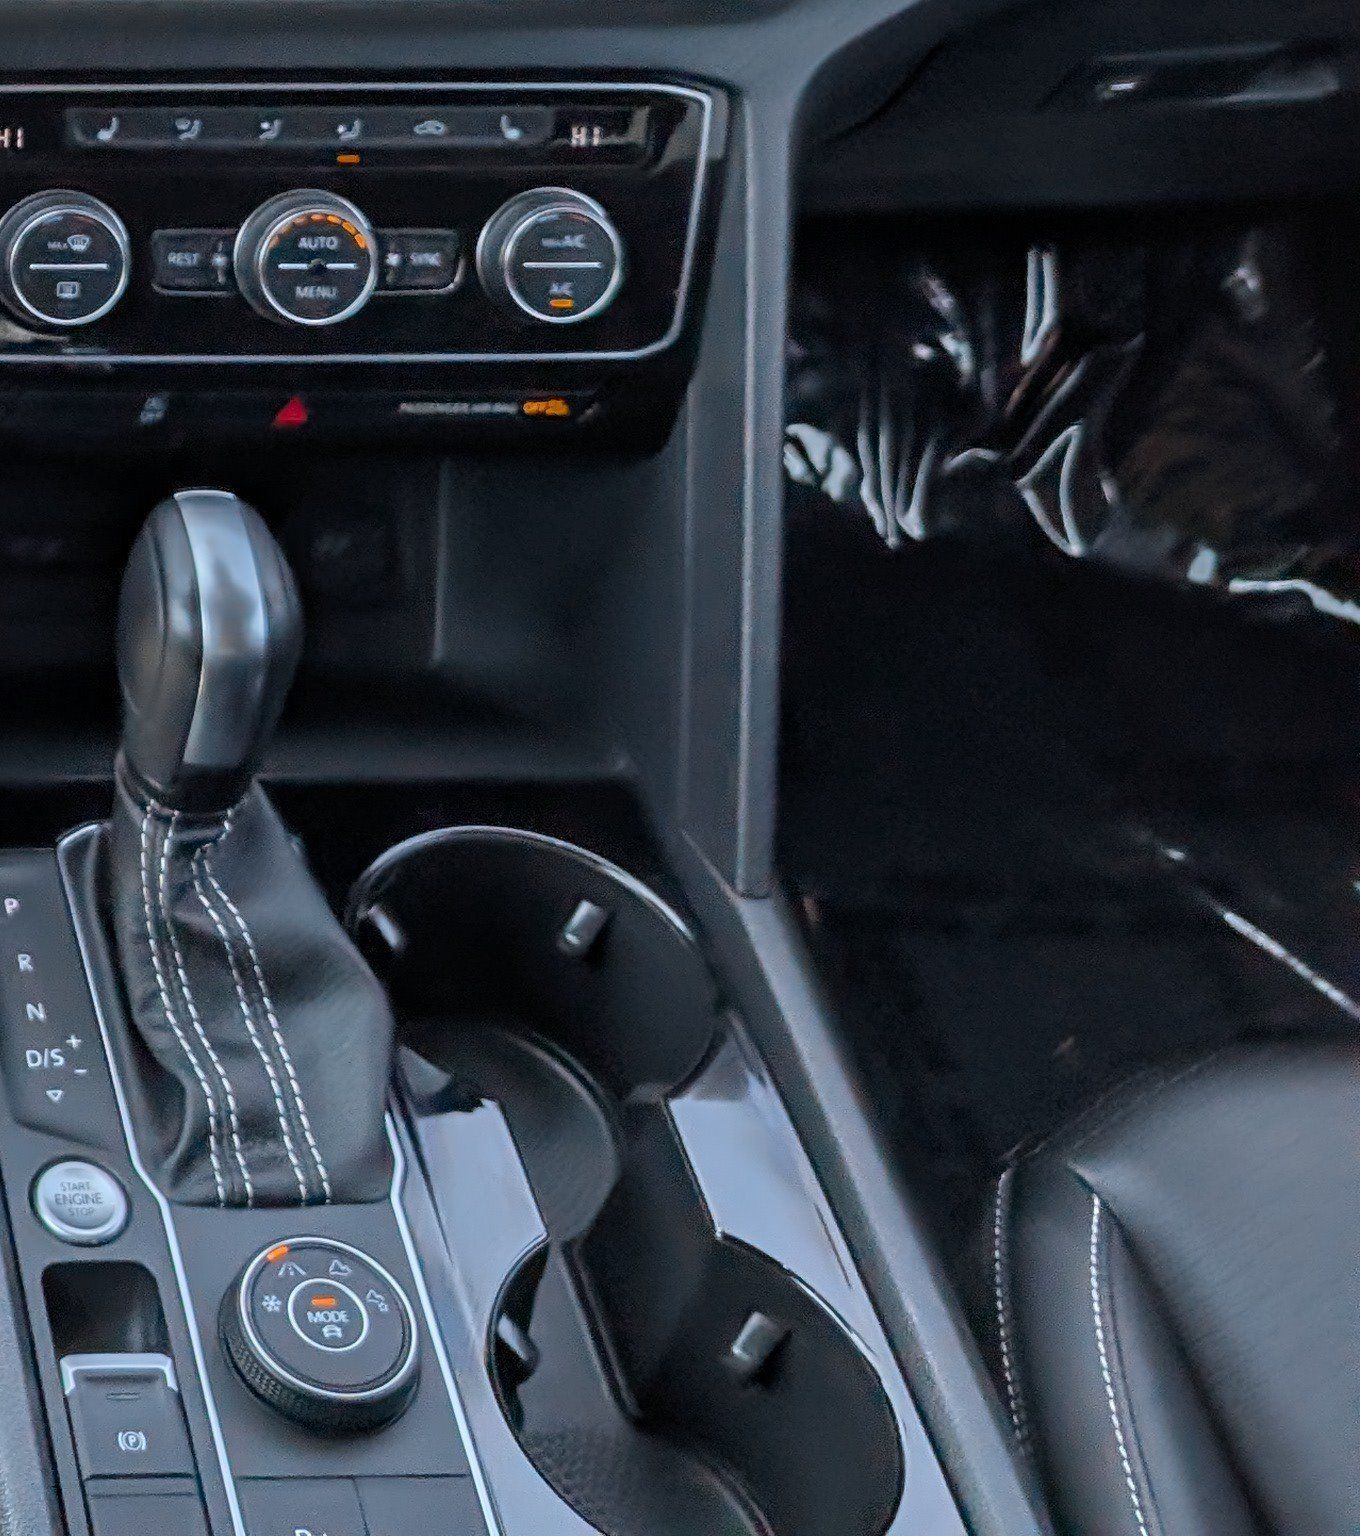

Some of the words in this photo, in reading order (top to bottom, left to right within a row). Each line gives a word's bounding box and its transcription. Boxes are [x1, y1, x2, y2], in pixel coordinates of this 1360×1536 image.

[298, 235, 340, 251] AUTO
[167, 252, 201, 266] REST
[409, 252, 442, 267] SYNC
[295, 285, 338, 300] MENU
[4, 897, 20, 914] P
[17, 953, 33, 972] R
[26, 1001, 47, 1022] N
[60, 1181, 91, 1192] START
[54, 1192, 104, 1206] ENGINE
[67, 1207, 96, 1217] STOP
[306, 1310, 350, 1323] MODE
